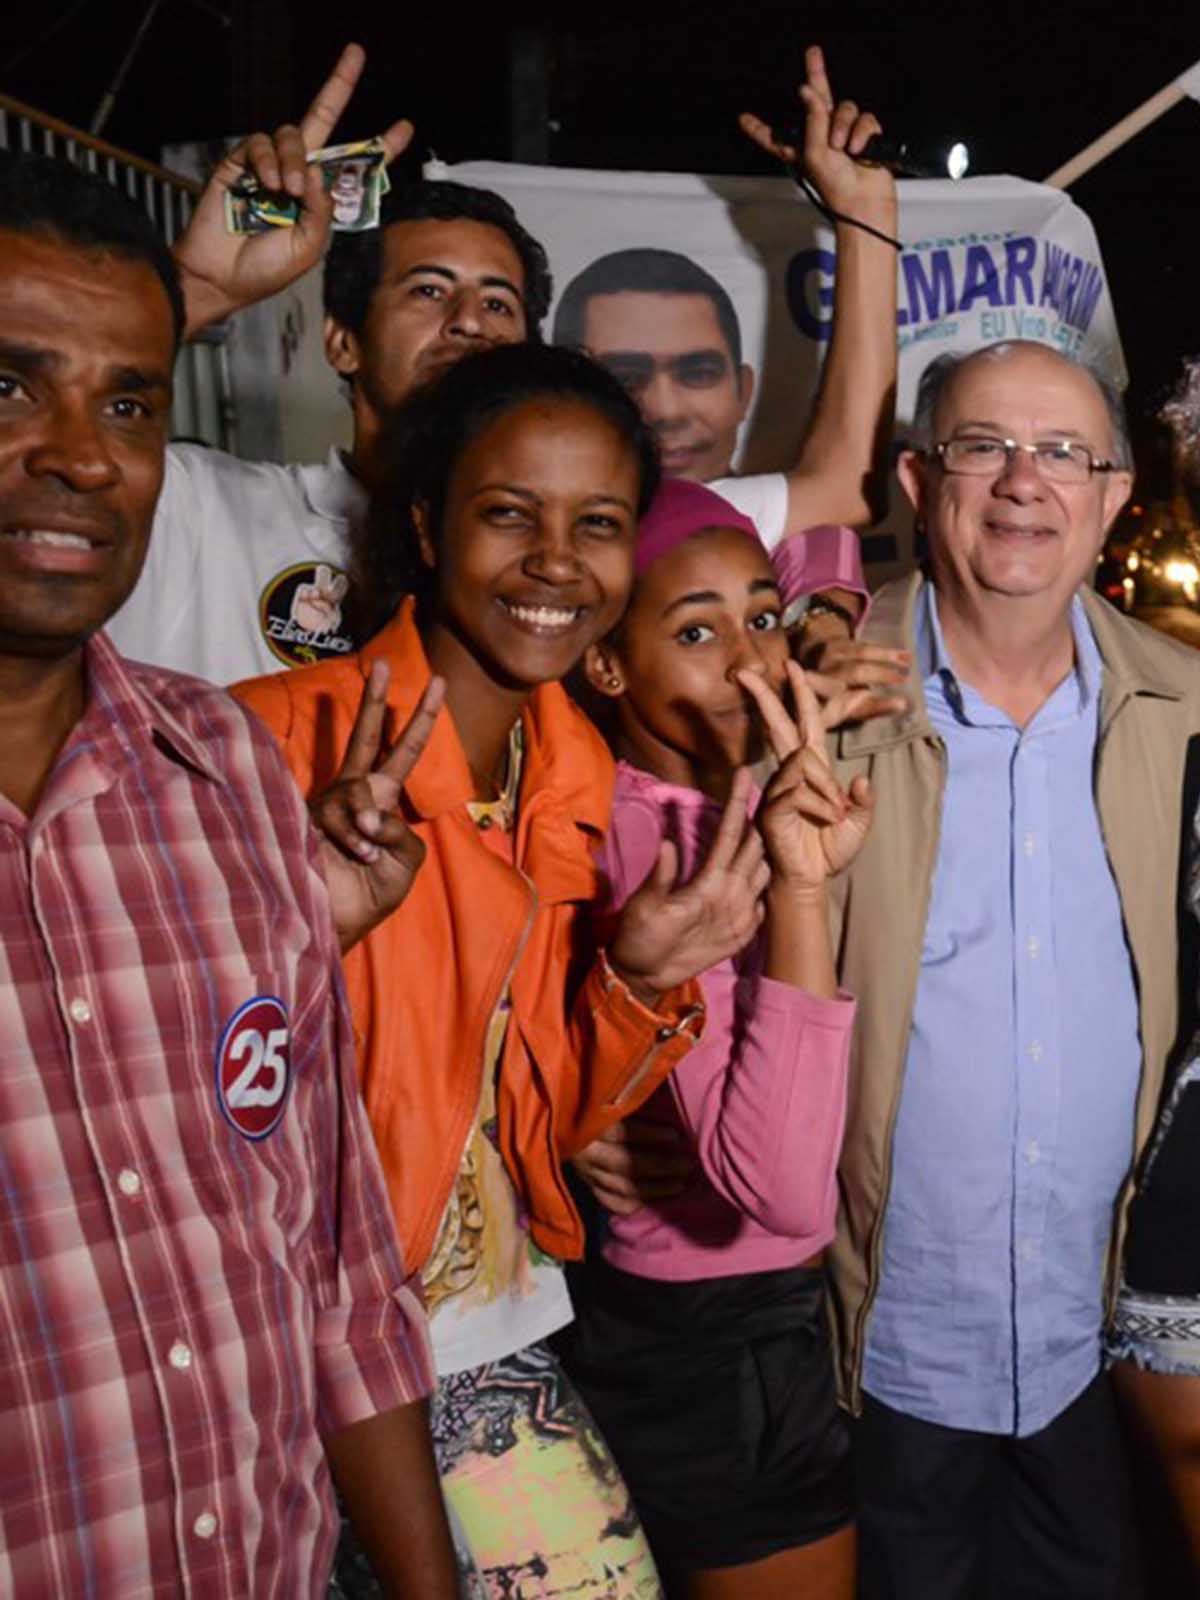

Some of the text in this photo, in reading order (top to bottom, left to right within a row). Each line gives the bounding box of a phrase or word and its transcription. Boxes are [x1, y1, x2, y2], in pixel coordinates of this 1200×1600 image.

[787, 236, 1037, 341] GMAR
[981, 312, 1006, 339] EU
[225, 1028, 289, 1109] 25
